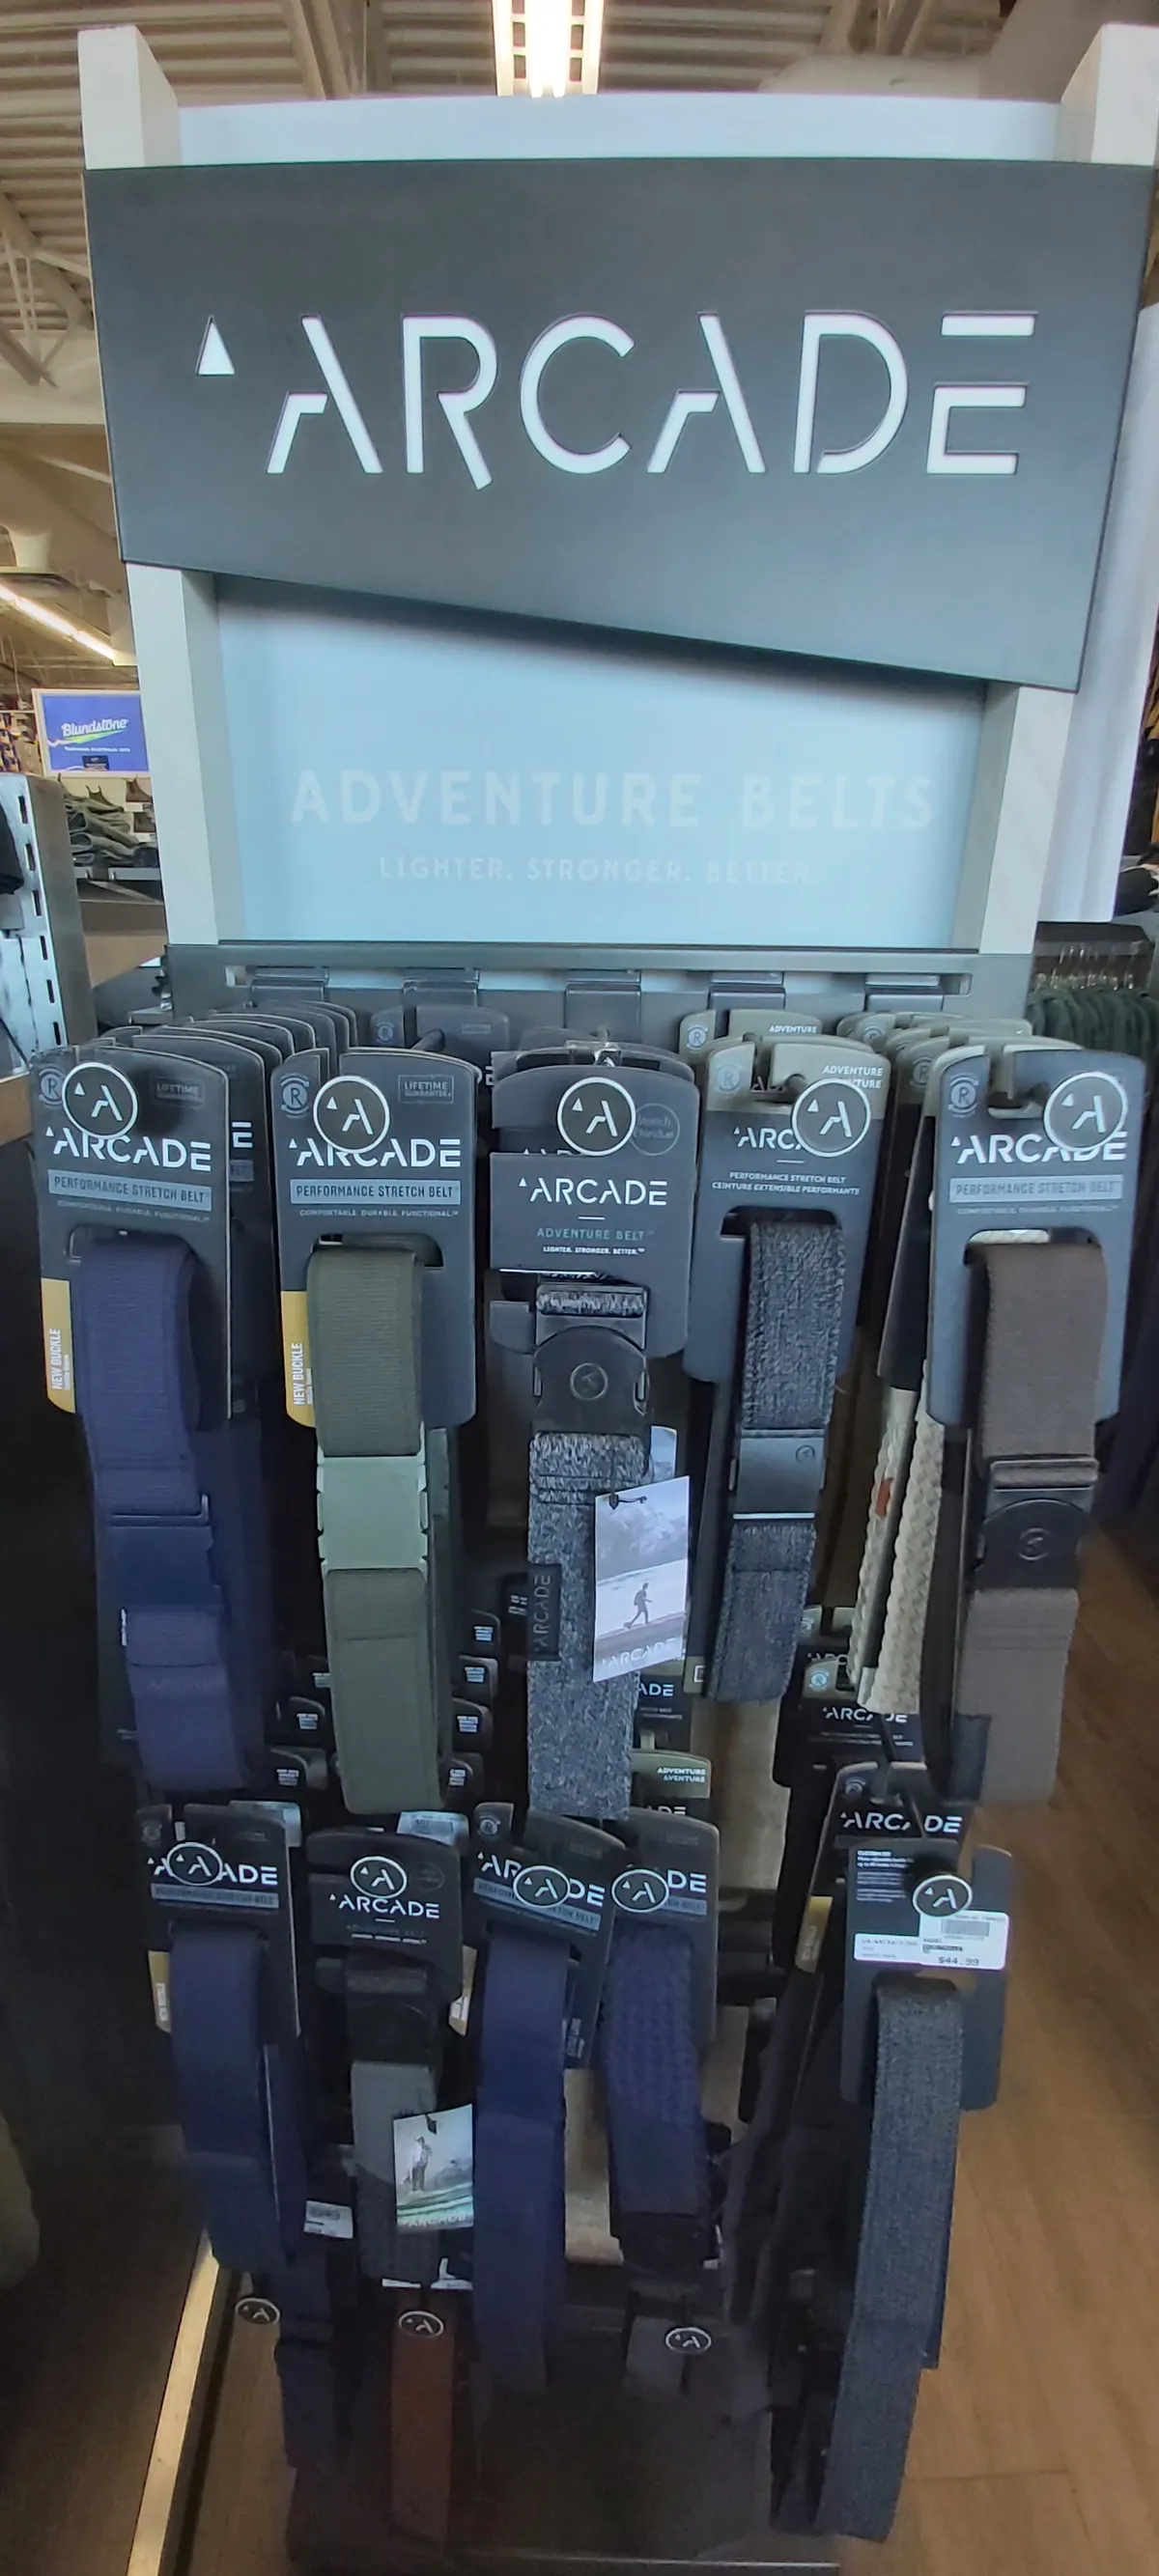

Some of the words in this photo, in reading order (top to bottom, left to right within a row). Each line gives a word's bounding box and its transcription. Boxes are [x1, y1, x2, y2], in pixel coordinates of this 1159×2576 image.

[267, 310, 1038, 490] ARCADE
[61, 718, 128, 737] Blundstone
[291, 770, 702, 827] ADVENTURE
[741, 774, 933, 831] BELTS
[380, 856, 513, 882] LIGHTER.
[526, 857, 692, 882] STRONGER.
[705, 860, 818, 885] BETTER.
[822, 1066, 884, 1077] ADVENTURE
[404, 1081, 448, 1091] LIFETIME
[53, 1127, 212, 1171] ARCADE
[737, 1127, 802, 1150] ARC
[957, 1131, 1128, 1164] ARCE
[53, 1175, 128, 1195] PERFORMANCE
[131, 1185, 178, 1201] STRETCH
[712, 1182, 752, 1190] CEINTURE
[754, 1184, 801, 1193] EXTENSIBLE
[729, 1171, 788, 1181] PERFORMANCE
[790, 1174, 826, 1184] STRETCH
[955, 1183, 1034, 1195] PERFORMANCE
[1037, 1182, 1086, 1194] STRETCH
[296, 1185, 375, 1197] PERFORMANCE
[378, 1185, 425, 1198] STRETCH
[530, 1177, 667, 1206] ARCADE
[537, 1228, 610, 1240] ADVENTURE
[49, 1328, 62, 1365] BUCKLE
[291, 1342, 304, 1381] BUCKLE
[51, 1366, 63, 1390] NEW
[293, 1382, 305, 1405] NEW
[825, 1707, 908, 1723] ARCE
[657, 1767, 706, 1776] ADVENTURE
[664, 1775, 706, 1783] AVENTURE
[842, 1811, 963, 1834] ARCDE
[154, 1857, 278, 1886] AADE
[481, 1854, 606, 1907] ARDE
[338, 1893, 439, 1919] ARCADE
[938, 1956, 979, 1967] $44.99
